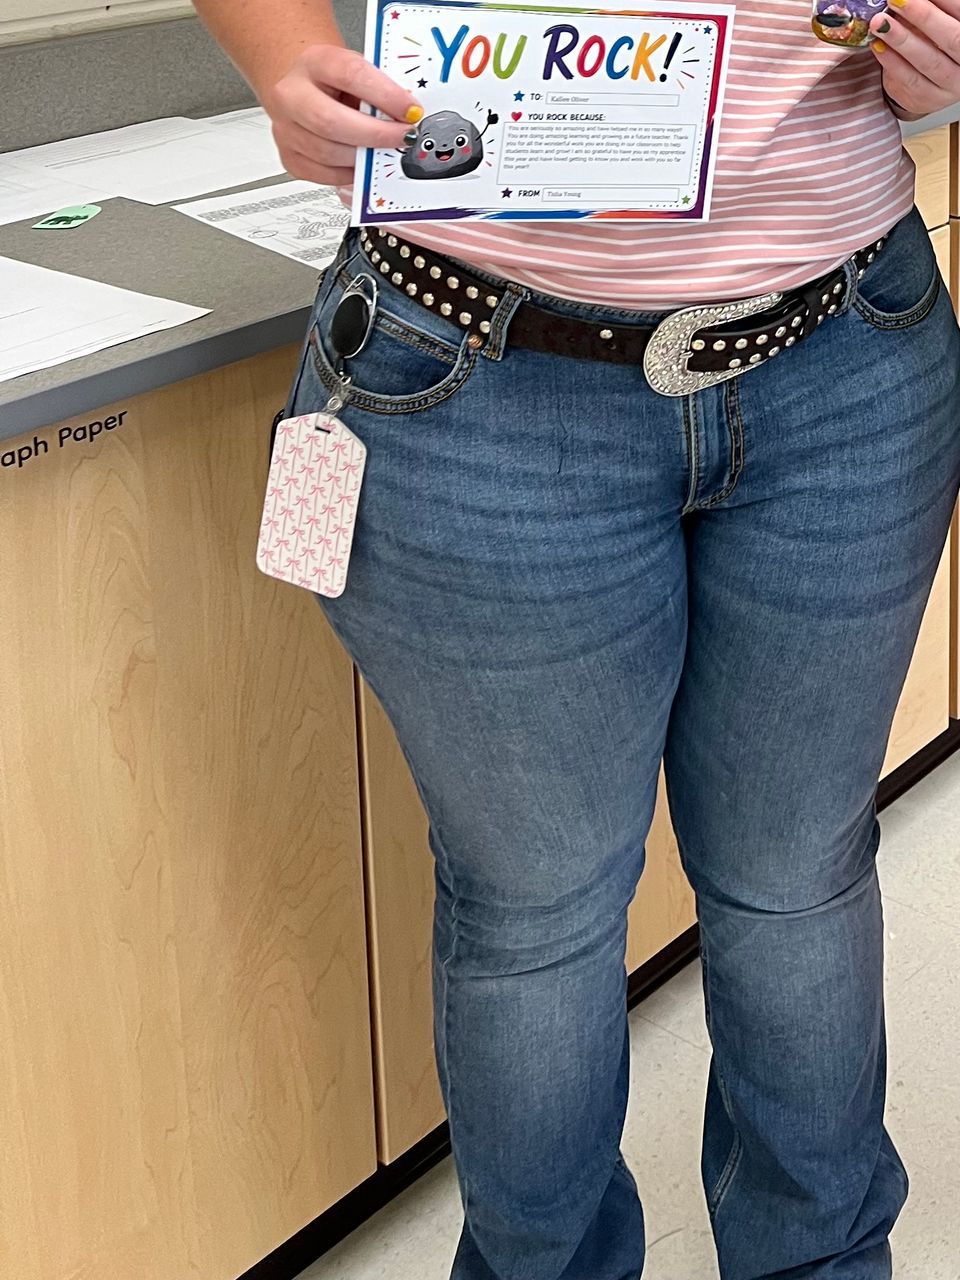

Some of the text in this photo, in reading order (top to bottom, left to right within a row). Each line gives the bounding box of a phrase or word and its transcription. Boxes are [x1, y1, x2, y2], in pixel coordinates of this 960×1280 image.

[431, 24, 683, 83] YOU ROCK!
[530, 93, 543, 101] TO:
[1, 410, 128, 468] aph Paper
